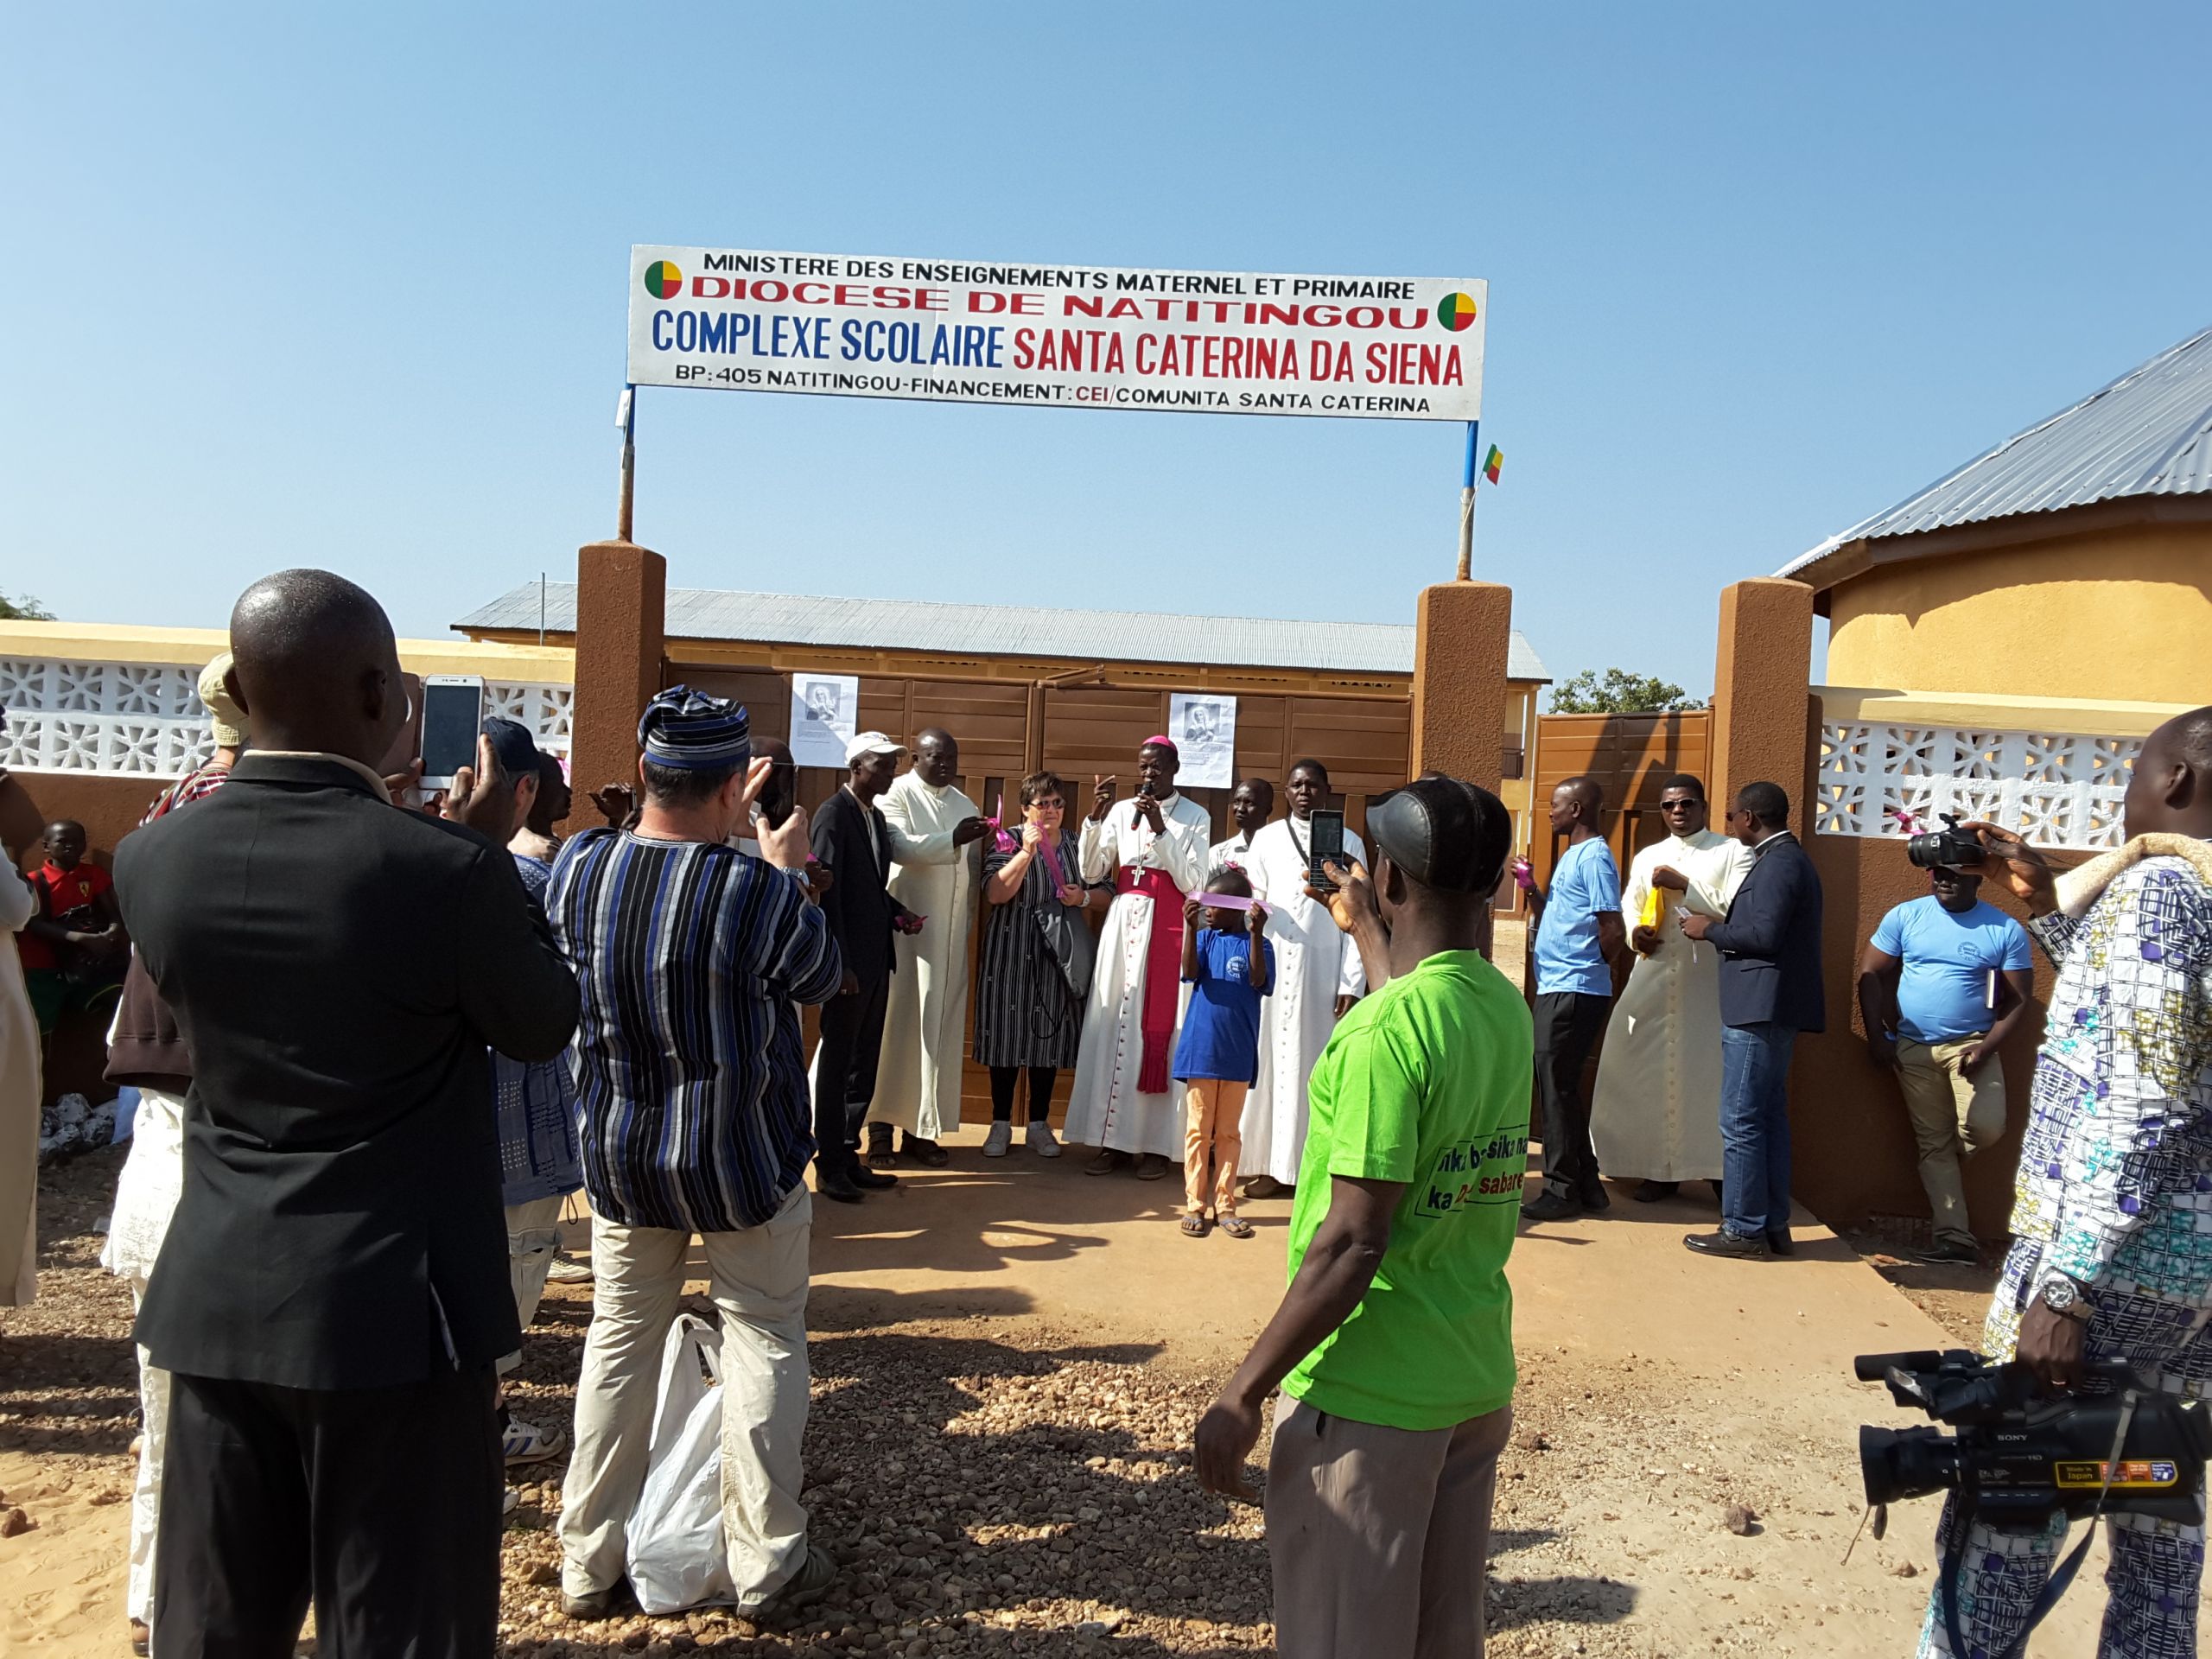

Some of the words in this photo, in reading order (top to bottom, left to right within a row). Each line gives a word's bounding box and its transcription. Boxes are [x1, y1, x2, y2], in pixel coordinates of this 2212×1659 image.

[703, 253, 839, 276] MINISTERE
[846, 260, 894, 278] DES
[902, 263, 1109, 289] ENSEIGNEMENTS
[1116, 273, 1247, 295] MATERNEL
[1255, 278, 1286, 296] ET
[1293, 279, 1415, 300] PRIMAIRE
[691, 276, 950, 311] DIOCESE
[968, 291, 1045, 315] DE
[1063, 295, 1428, 330] NATITINGOU
[652, 309, 831, 359] COMPLEXE
[841, 319, 1005, 369] SCOLAIRE
[1014, 327, 1124, 374] SANTA
[1135, 333, 1300, 381] CATERINA
[1310, 340, 1354, 383] DA
[1365, 342, 1463, 386] SIENA
[1239, 392, 1313, 409] SANTA
[1321, 395, 1430, 413] CATERINA
